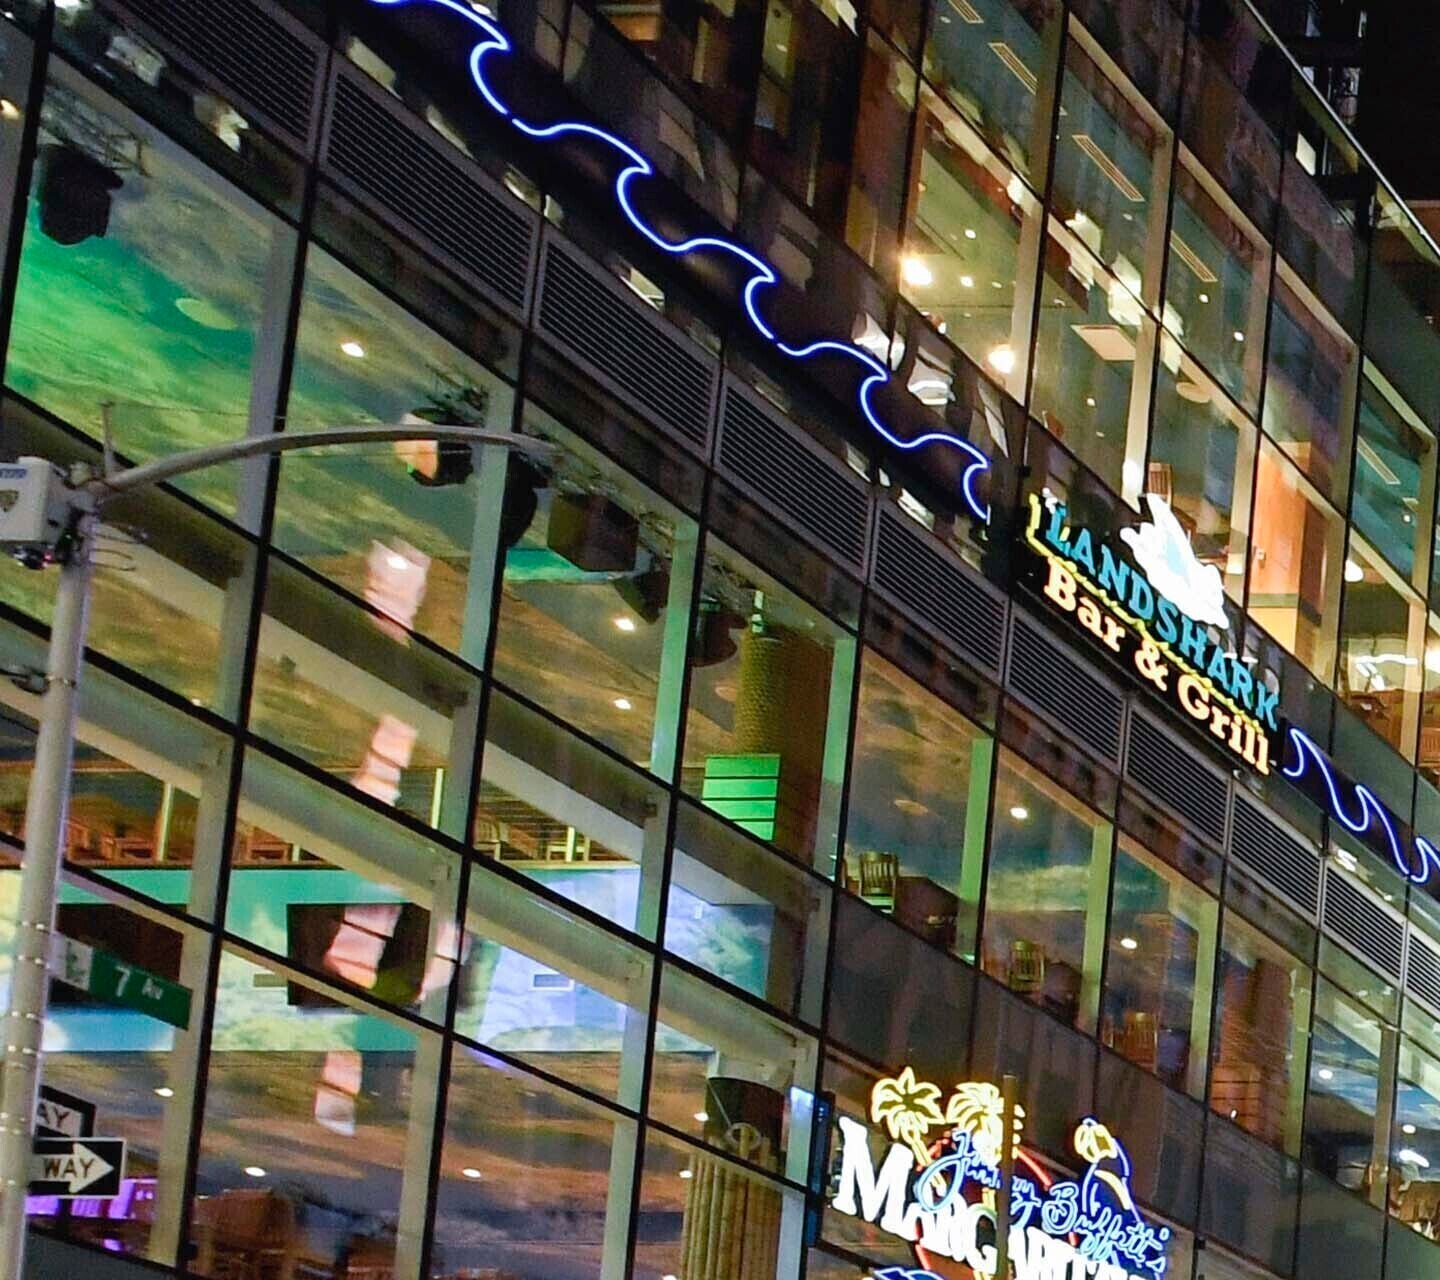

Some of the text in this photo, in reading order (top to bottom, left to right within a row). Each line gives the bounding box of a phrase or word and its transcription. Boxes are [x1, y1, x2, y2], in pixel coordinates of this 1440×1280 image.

[1045, 502, 1279, 731] LANDSHARK
[1044, 556, 1270, 776] Bar & Grill
[116, 965, 130, 998] 7
[36, 1103, 71, 1129] AY
[42, 1156, 96, 1180] WAY
